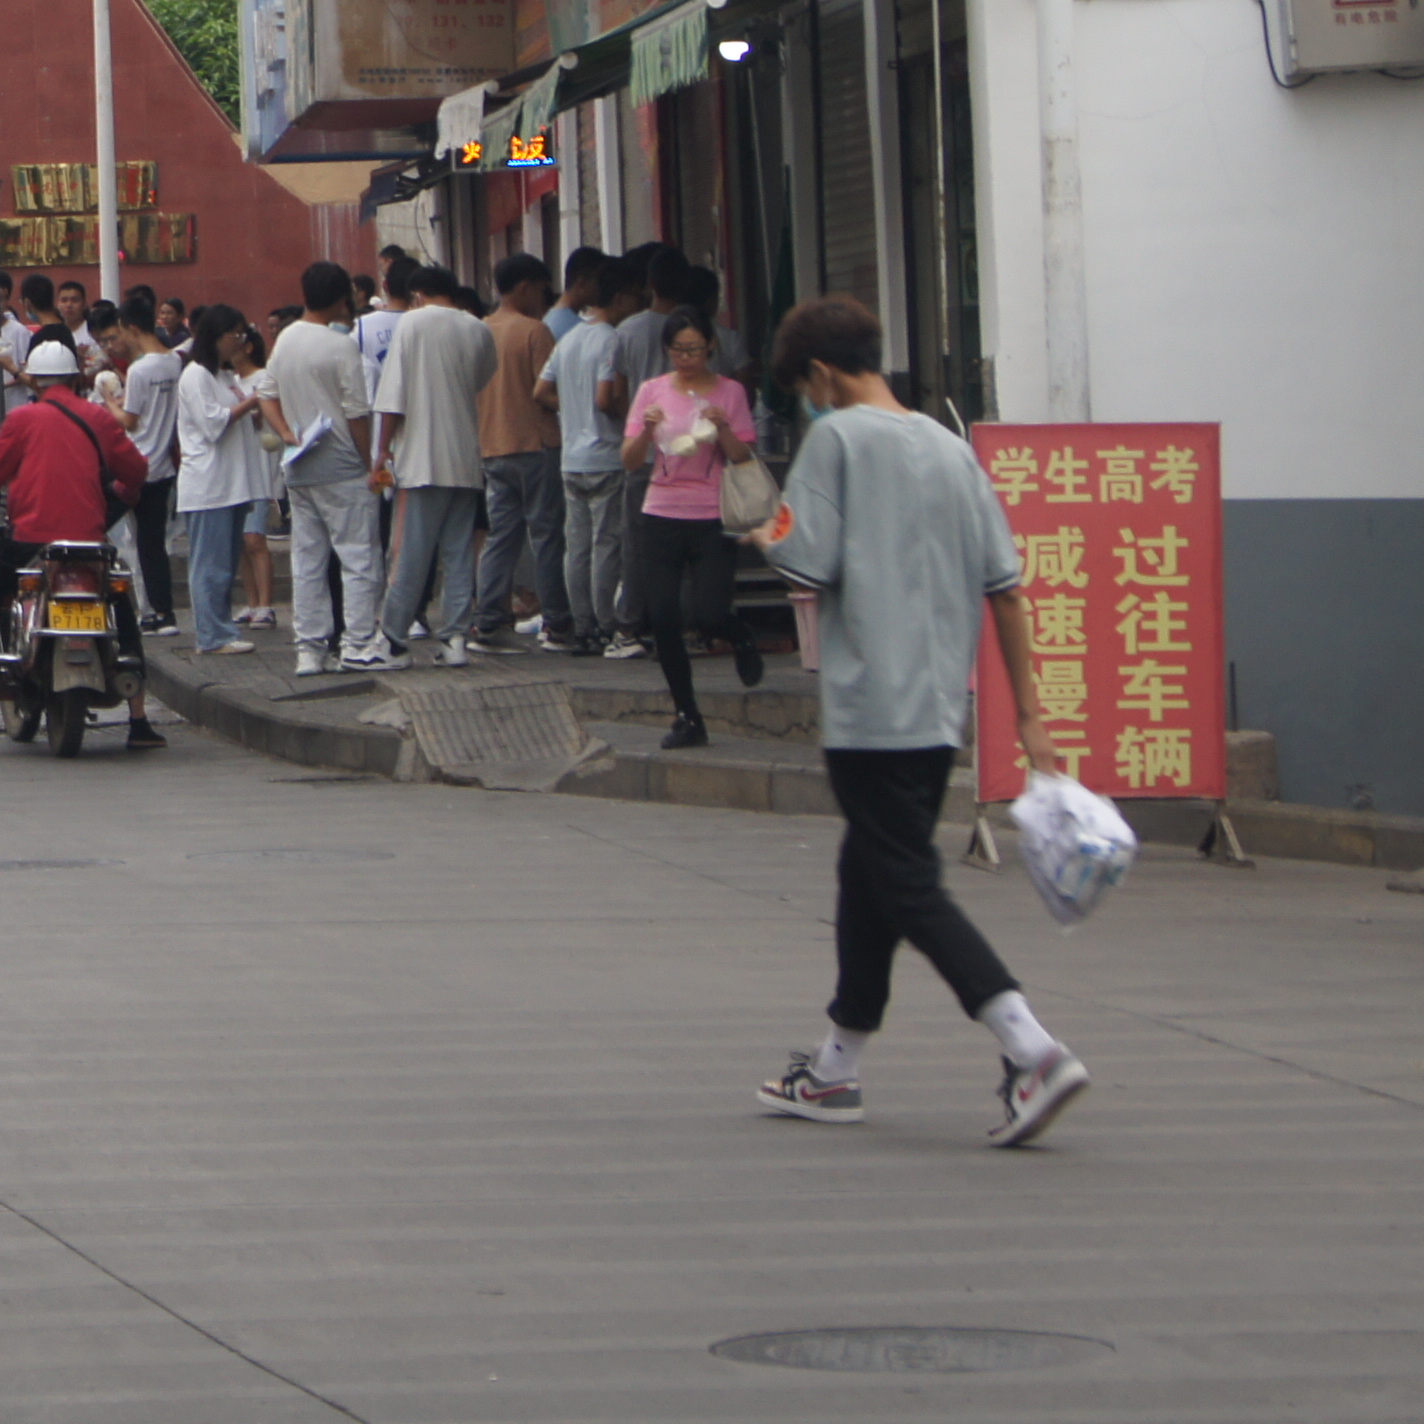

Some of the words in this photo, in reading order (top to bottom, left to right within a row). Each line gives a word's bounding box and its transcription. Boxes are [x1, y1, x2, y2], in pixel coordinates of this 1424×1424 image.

[1334, 10, 1398, 25] 有电危险
[989, 445, 1200, 506] 学生高考
[1112, 525, 1192, 789] 过往车辆
